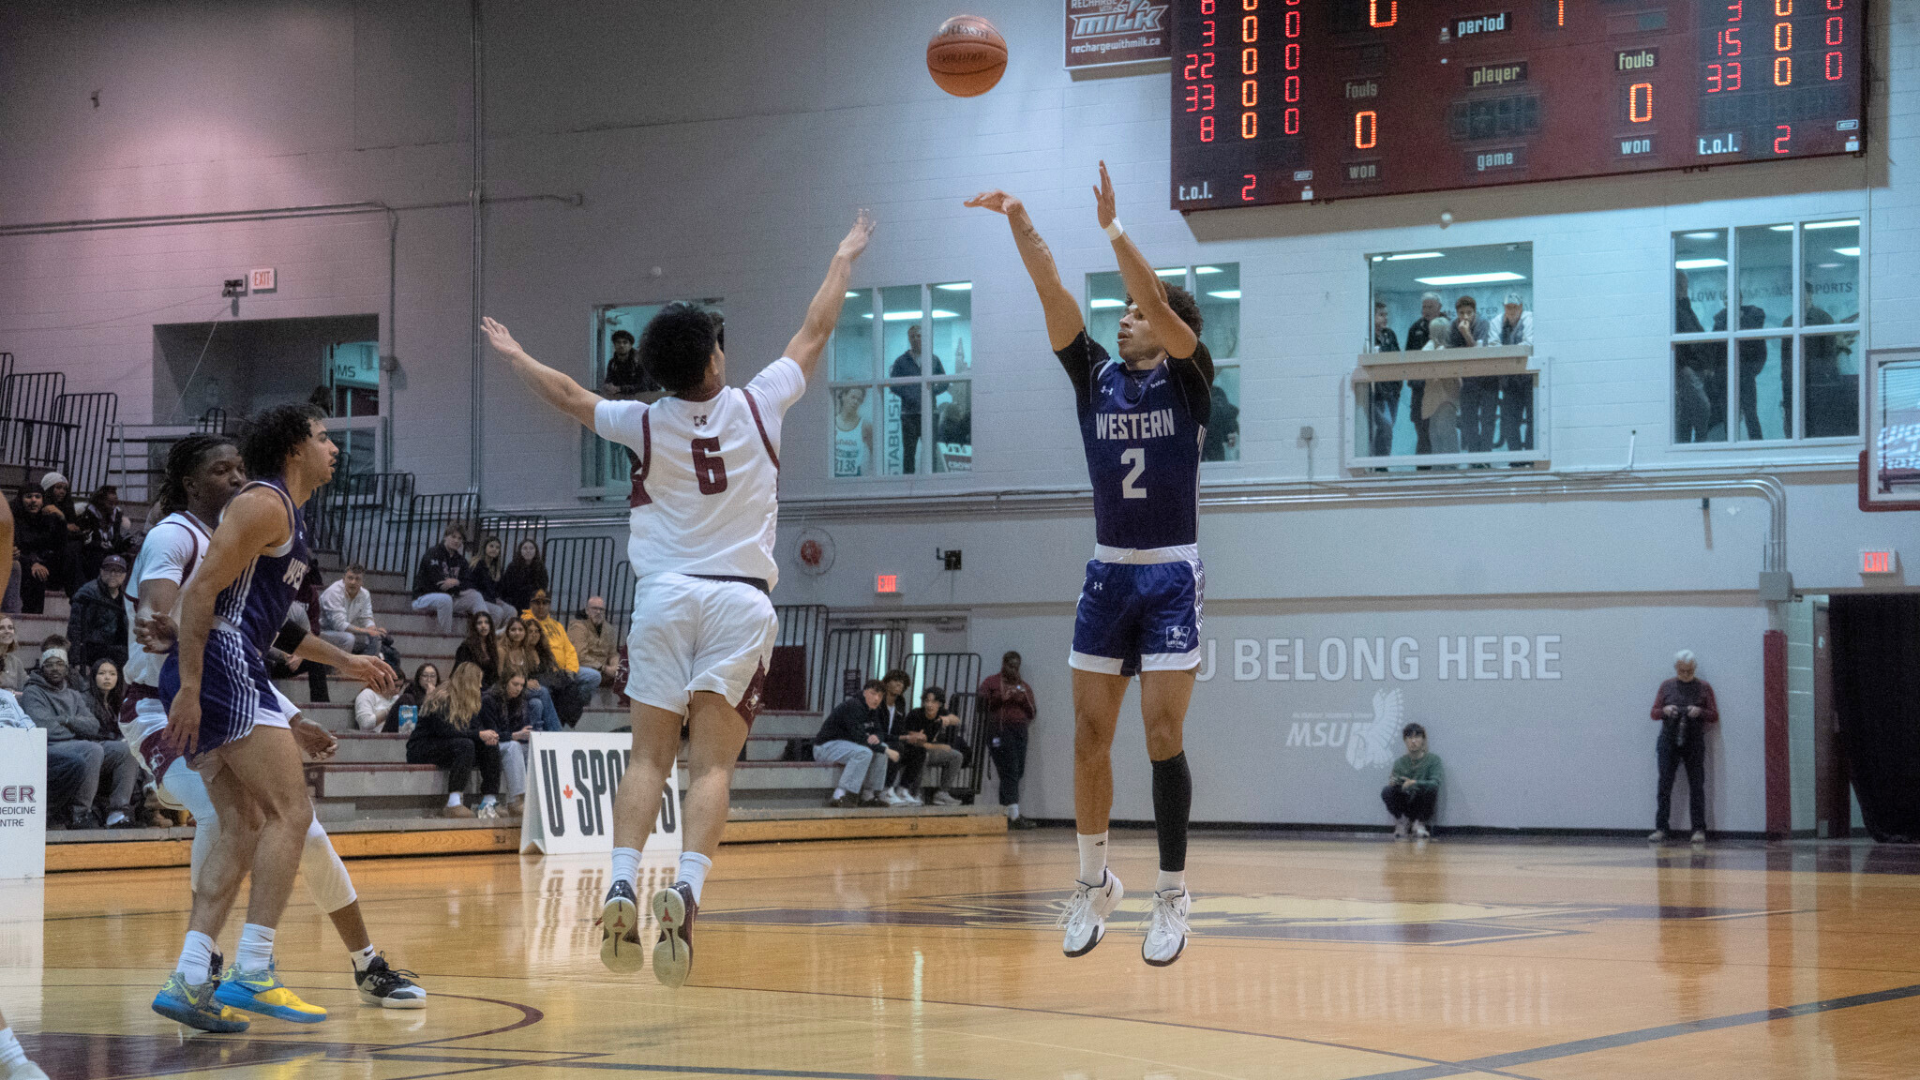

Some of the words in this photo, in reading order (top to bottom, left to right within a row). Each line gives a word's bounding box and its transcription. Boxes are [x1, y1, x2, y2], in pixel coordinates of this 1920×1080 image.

[1076, 10, 1160, 35] MILK
[1203, 20, 1216, 47] 3
[1242, 15, 1258, 43] 0
[1285, 11, 1300, 38] 0
[1458, 13, 1505, 38] period
[1071, 36, 1161, 54] rechargewithmilk.ca
[1717, 27, 1742, 57] 15
[1774, 22, 1793, 51] 0
[1826, 16, 1844, 46] 0
[1184, 52, 1216, 80] 22
[1242, 47, 1258, 75] 0
[1285, 43, 1300, 71] 0
[1619, 51, 1655, 70] fouls
[1707, 62, 1742, 93] 33
[1774, 57, 1793, 86] 0
[1825, 51, 1843, 81] 0
[1345, 80, 1378, 99] fouls
[1473, 66, 1520, 87] player
[1185, 84, 1215, 112] 33
[1242, 79, 1258, 107] 0
[1285, 75, 1300, 102] 0
[1629, 82, 1653, 123] 0
[1200, 116, 1215, 142] 8
[1242, 111, 1257, 139] 0
[1284, 107, 1300, 135] 0
[1355, 110, 1377, 149] 0
[1621, 139, 1651, 155] won
[1699, 133, 1739, 155] t.o.l.
[1774, 125, 1791, 154] 2
[1349, 164, 1376, 179] won
[1477, 152, 1514, 171] game
[1179, 181, 1213, 200] t.o.l.
[1242, 174, 1256, 201] 2
[254, 271, 271, 286] EXIT
[1096, 408, 1175, 440] WESTERN
[691, 436, 728, 495] 6
[1120, 448, 1147, 499] 2
[1864, 552, 1889, 572] EXIT
[877, 575, 897, 592] EXIT
[1233, 636, 1420, 682] BELONG
[1438, 634, 1563, 680] HERE
[1285, 721, 1349, 747] MSU
[1, 785, 37, 803] ER
[540, 749, 565, 837] U
[0, 806, 36, 815] EDICINE
